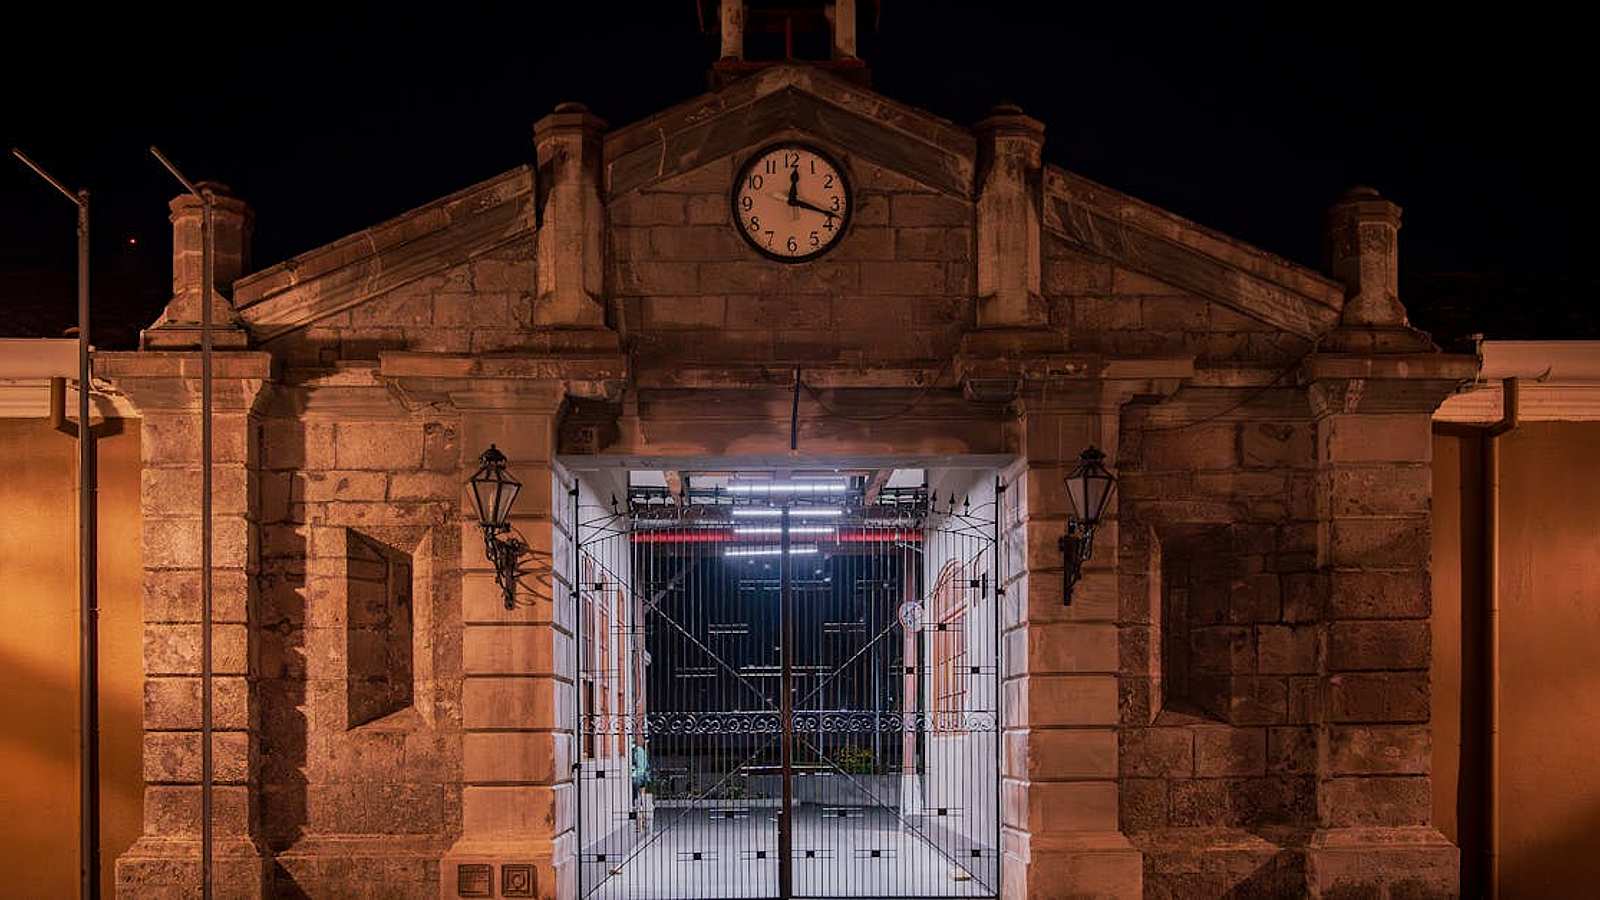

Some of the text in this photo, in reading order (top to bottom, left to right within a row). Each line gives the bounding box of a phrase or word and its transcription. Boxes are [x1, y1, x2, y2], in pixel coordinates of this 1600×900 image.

[766, 160, 776, 174] 11
[785, 153, 800, 168] 12
[810, 160, 815, 174] 1
[749, 175, 763, 190] 10
[824, 175, 833, 188] 2
[742, 196, 753, 211] 9
[830, 196, 840, 211] 3
[750, 216, 760, 231] 8
[765, 231, 774, 246] 7
[787, 236, 797, 252] 6
[810, 231, 819, 246] 5
